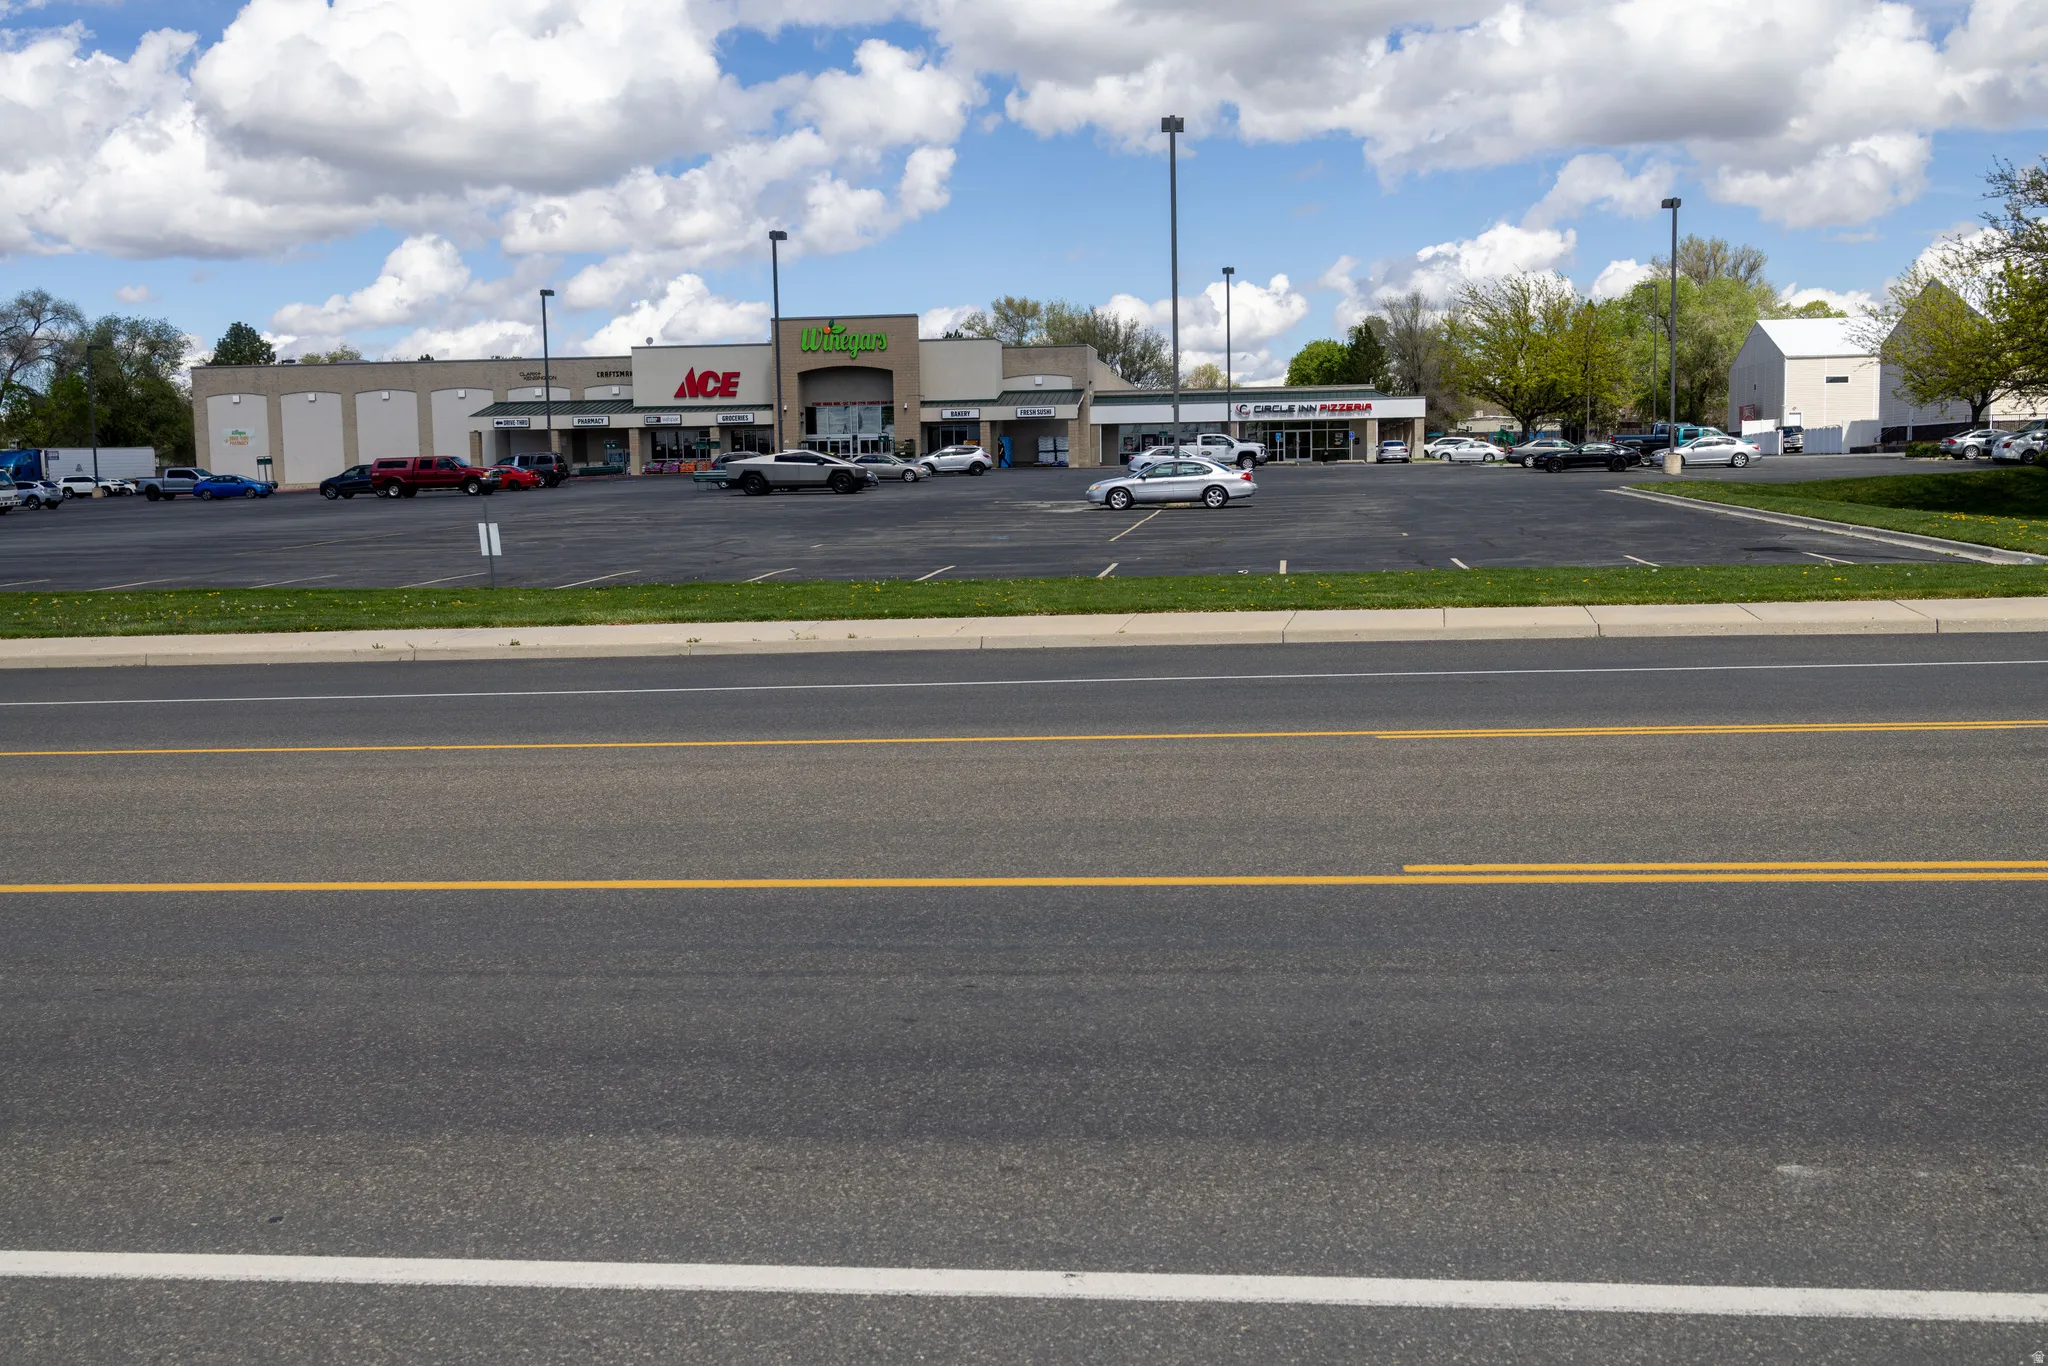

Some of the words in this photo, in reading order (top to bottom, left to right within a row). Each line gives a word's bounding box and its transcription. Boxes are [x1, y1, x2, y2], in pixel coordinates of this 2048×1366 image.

[801, 327, 888, 358] Winegars
[673, 366, 741, 398] ACE
[1253, 404, 1295, 413] CIRCLE
[1298, 404, 1318, 413] INN
[1319, 403, 1373, 412] PIZZERIA
